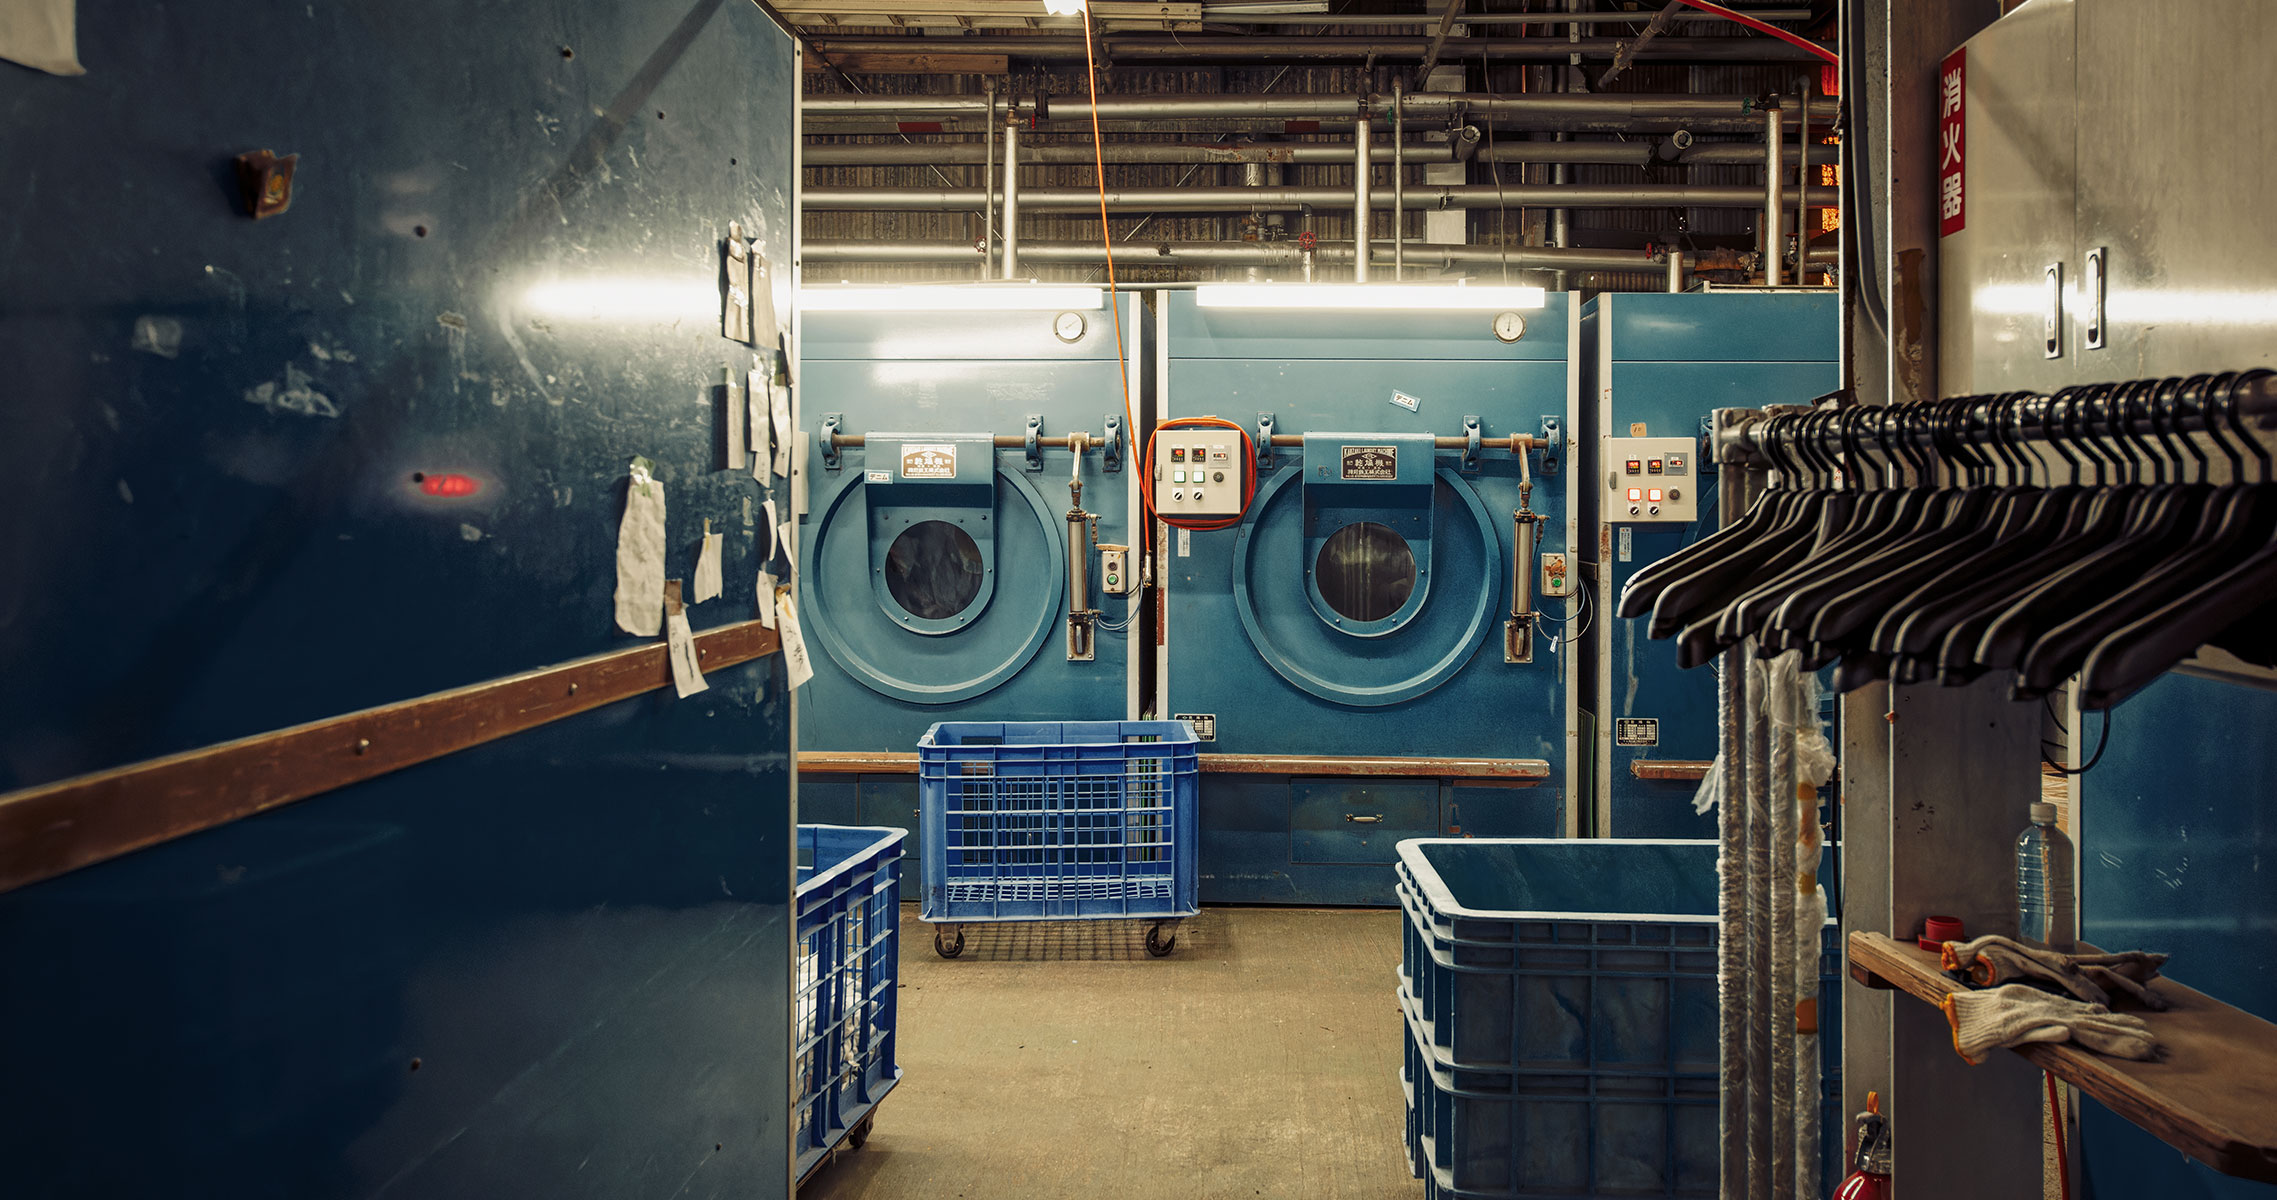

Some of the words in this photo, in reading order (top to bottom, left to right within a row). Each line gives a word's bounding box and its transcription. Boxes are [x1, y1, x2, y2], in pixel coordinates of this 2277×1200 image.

[1942, 67, 1962, 220] 消火器
[1396, 395, 1413, 405] デニム
[870, 473, 888, 481] デニム
